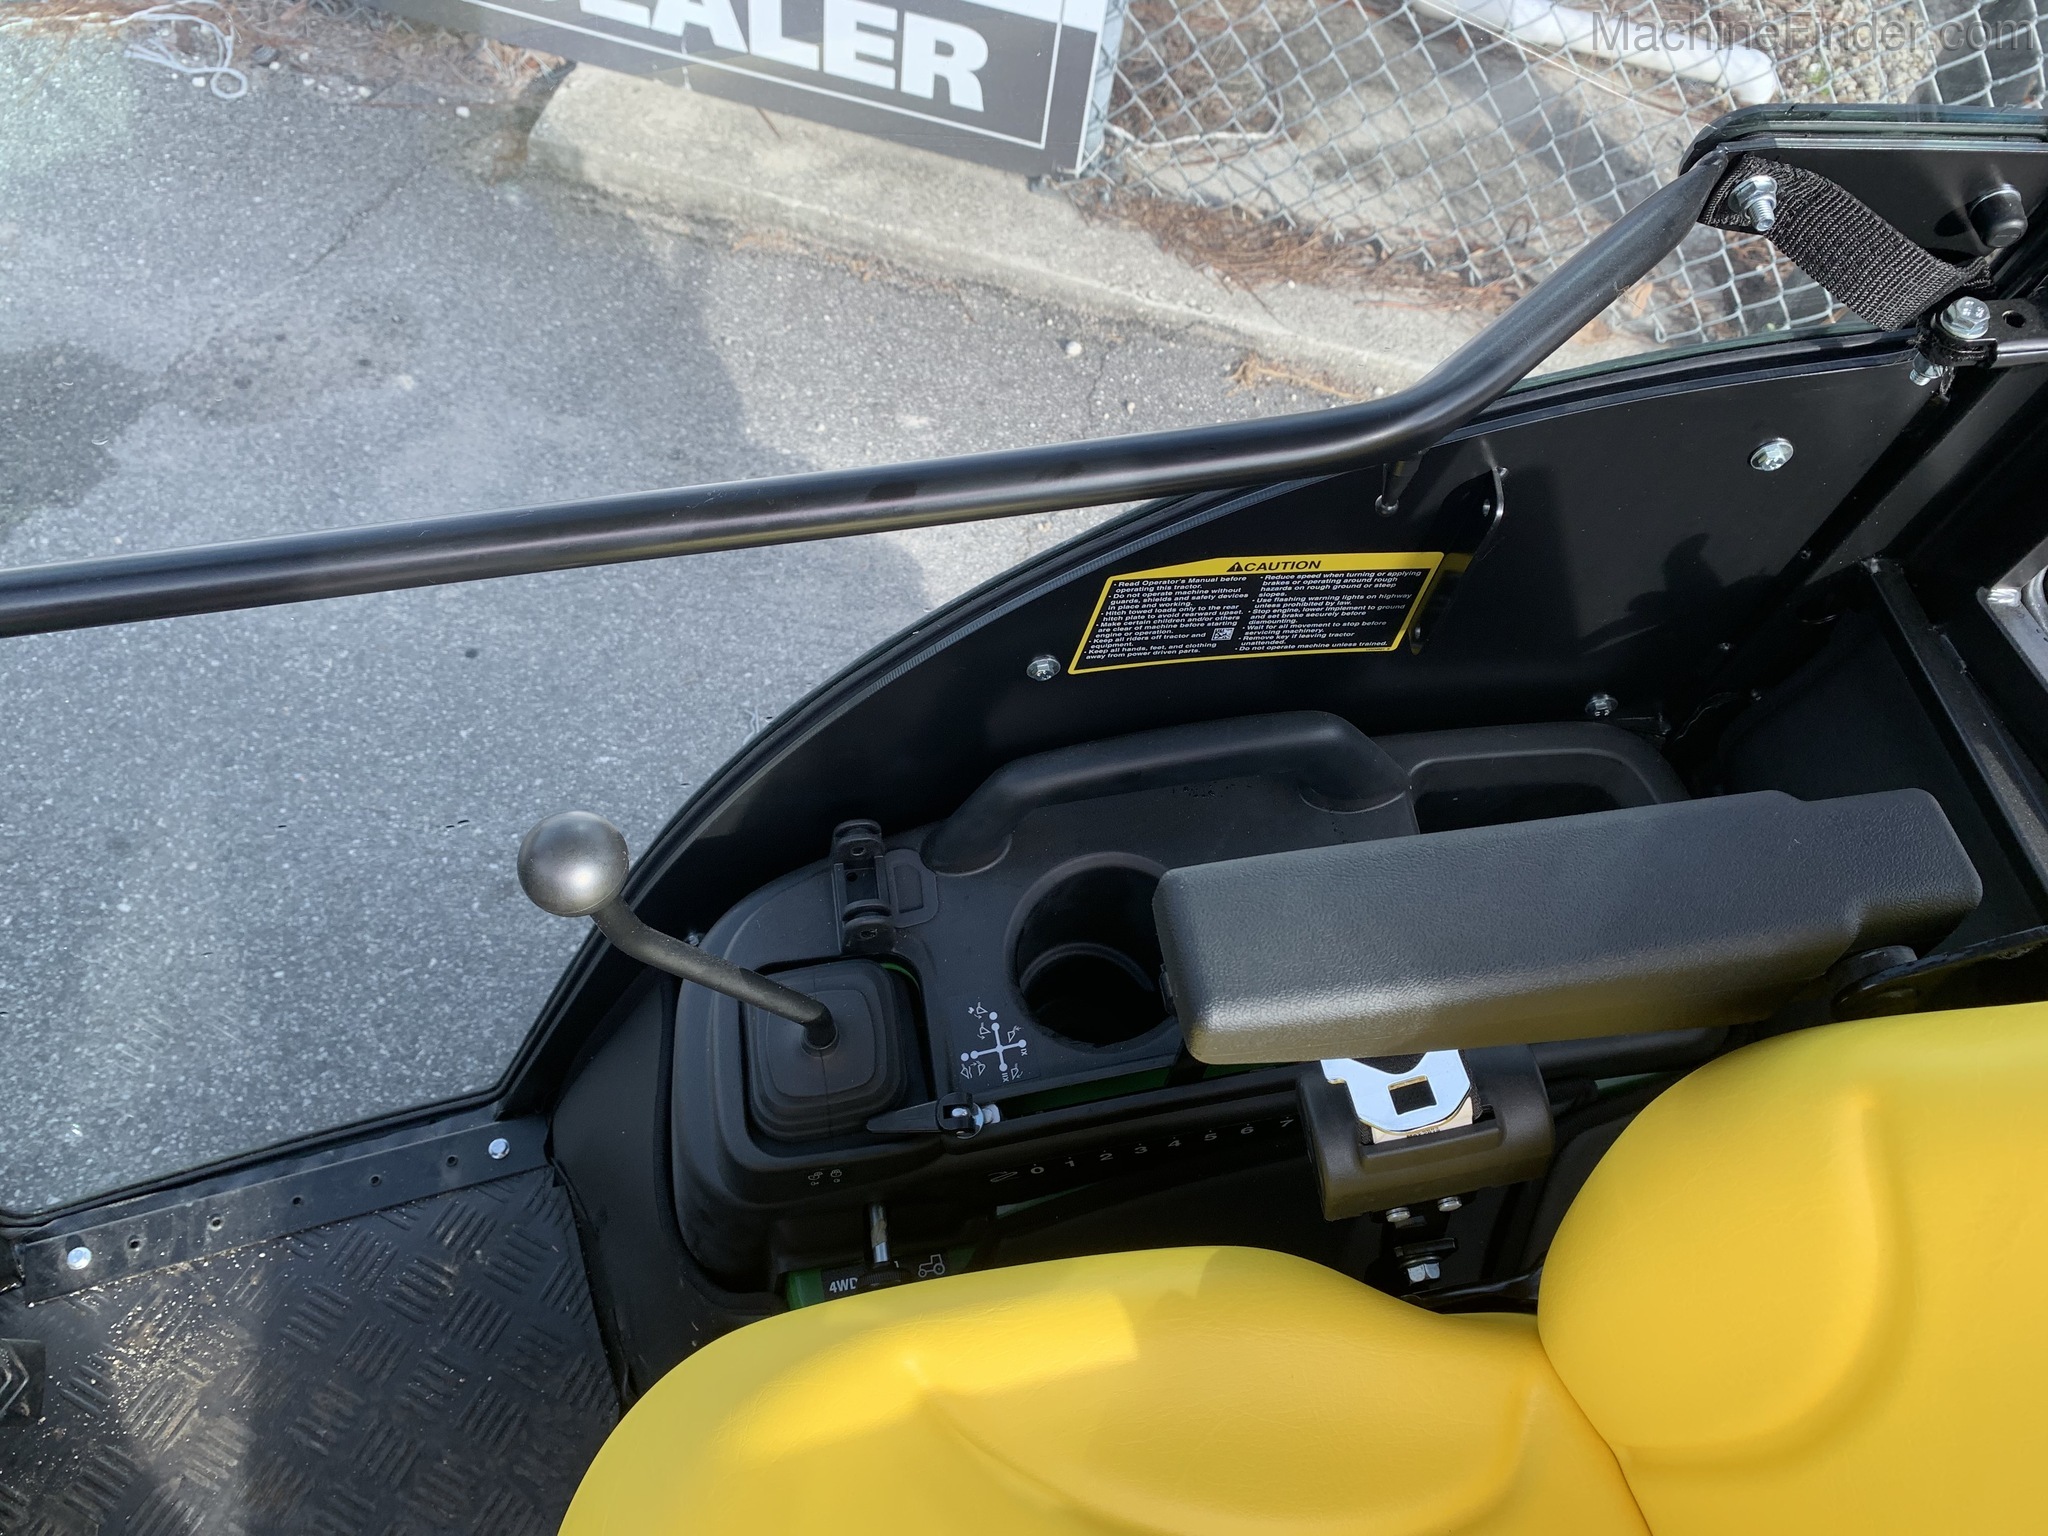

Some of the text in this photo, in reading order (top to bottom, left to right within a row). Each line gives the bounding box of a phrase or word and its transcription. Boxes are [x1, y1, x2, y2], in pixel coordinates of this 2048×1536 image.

[1244, 560, 1322, 572] CAUTION
[1141, 578, 1186, 586] Operator's
[1115, 585, 1155, 593] operating
[1141, 590, 1174, 598] operate
[1095, 631, 1123, 639] engine
[1030, 1118, 1295, 1175] 0 1 2 3 4 5 6 7
